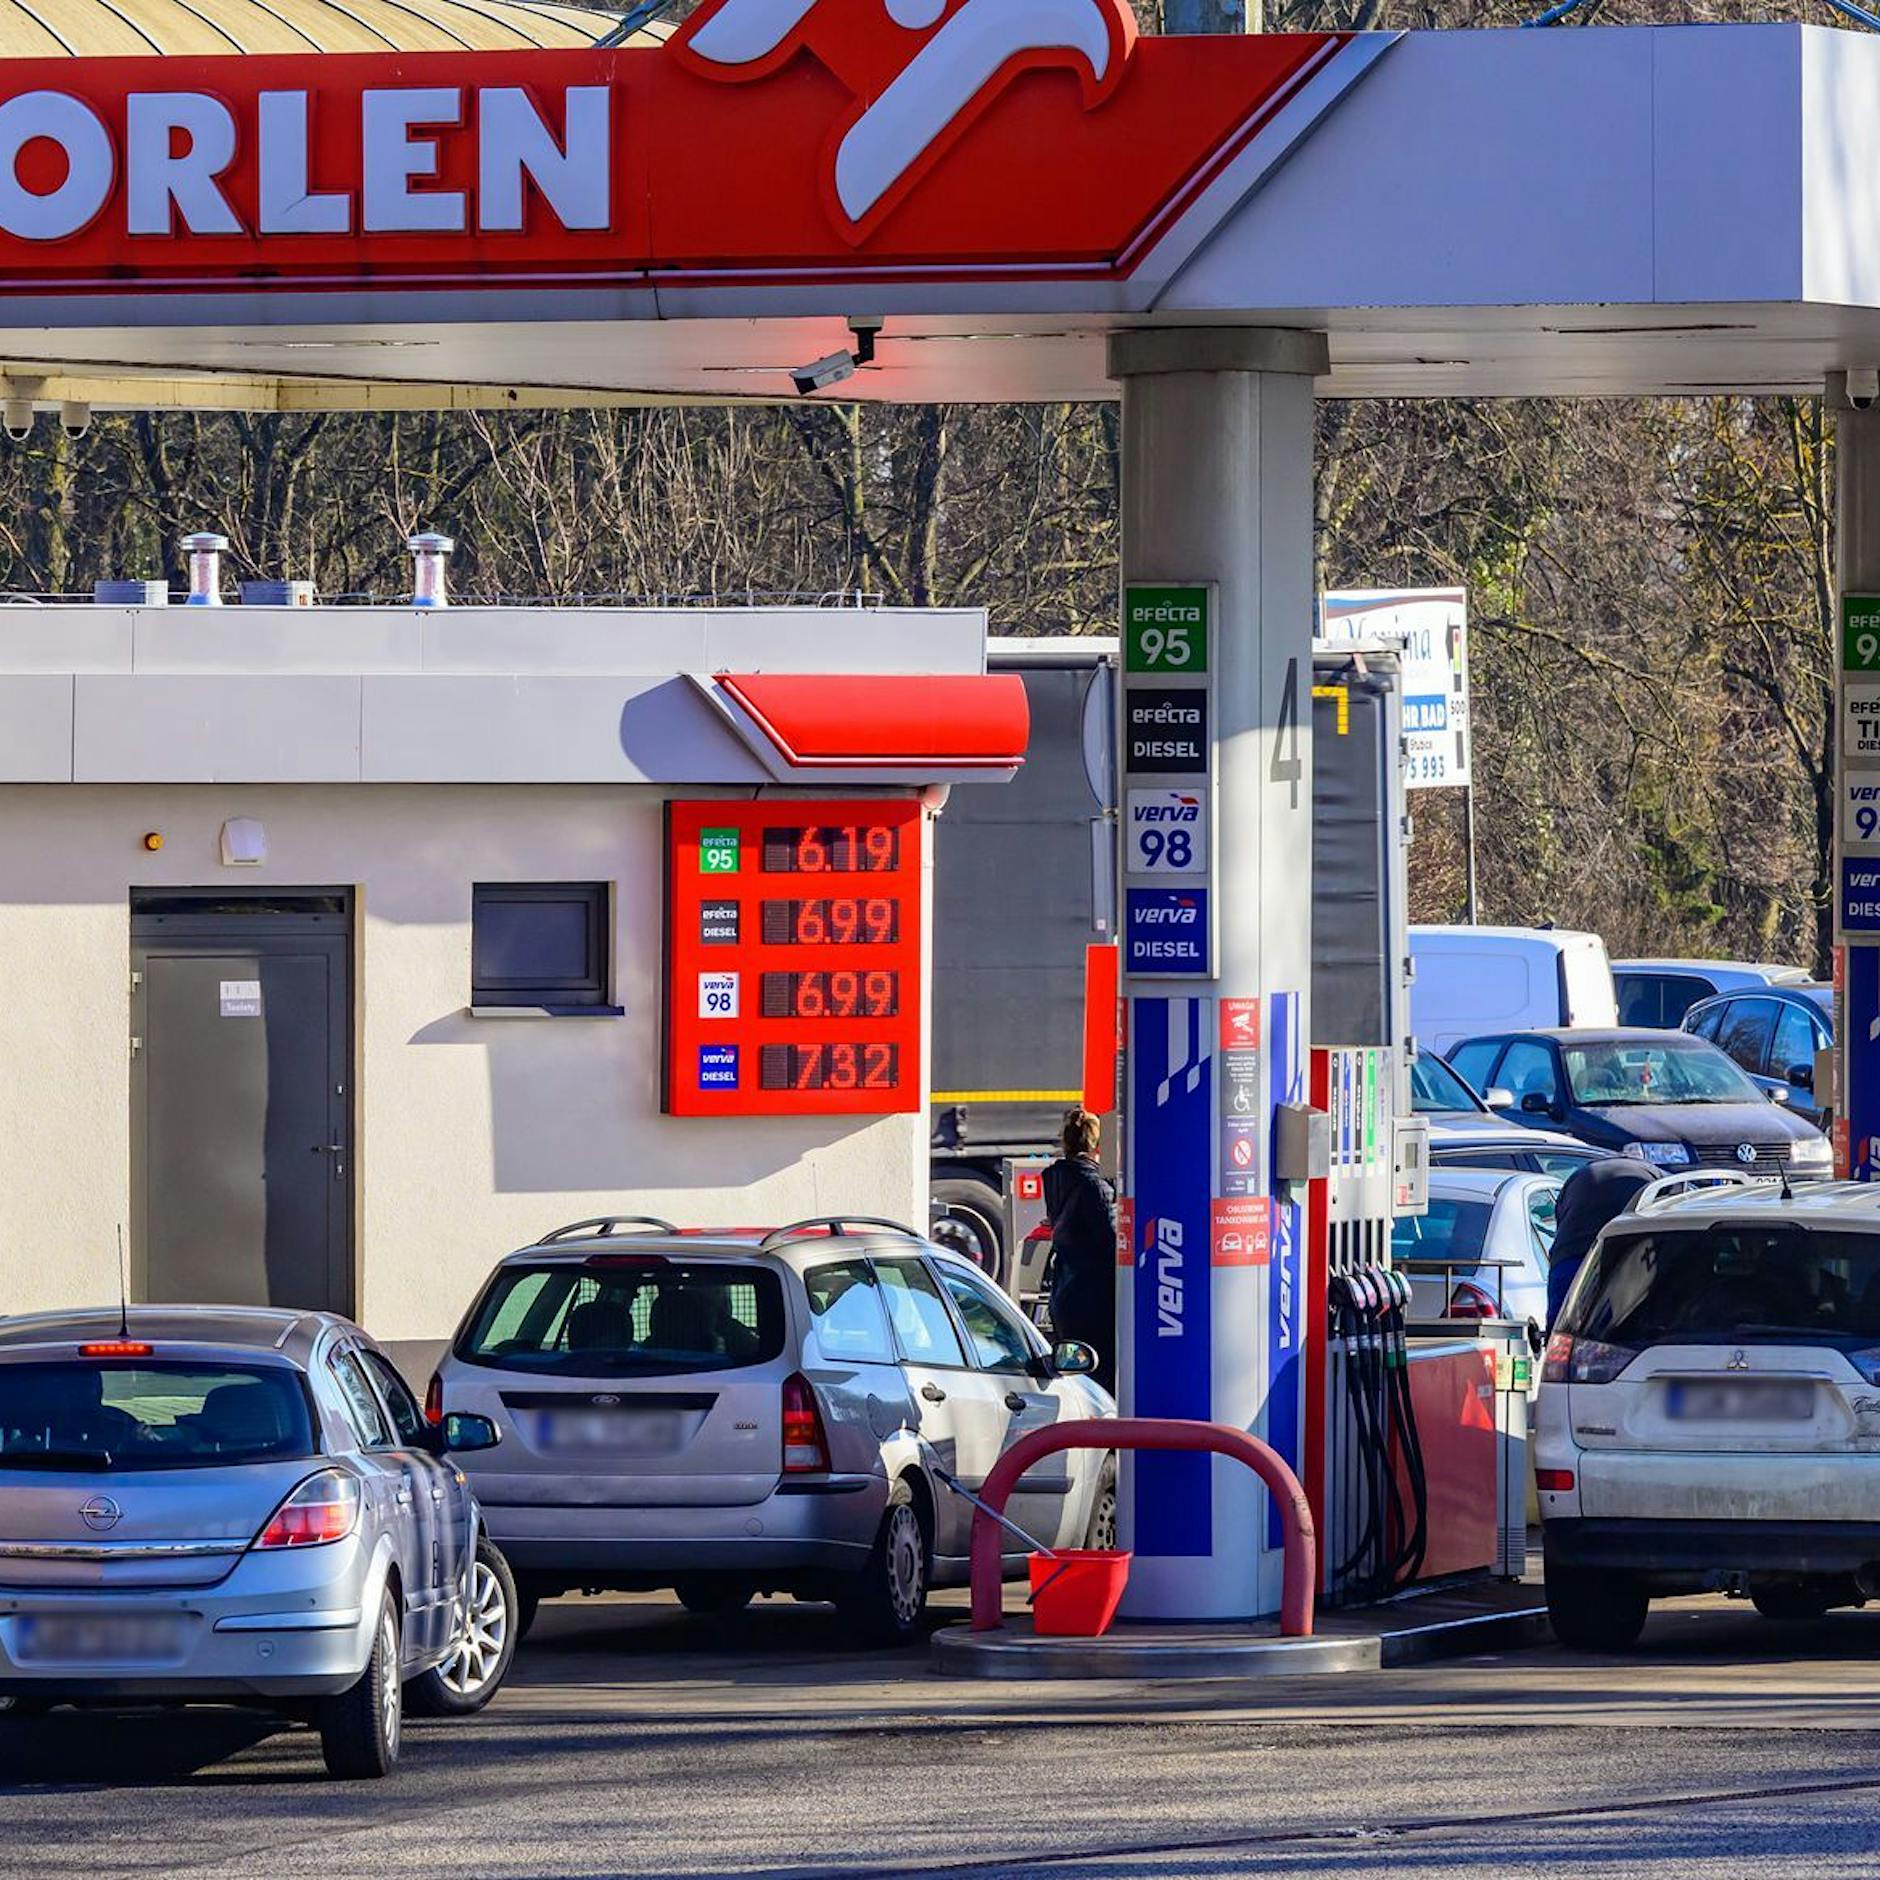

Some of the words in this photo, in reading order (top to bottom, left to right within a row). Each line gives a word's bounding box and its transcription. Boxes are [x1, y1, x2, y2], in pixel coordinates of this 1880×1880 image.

[0, 85, 612, 241] ORLEN
[1140, 628, 1191, 666] 95
[1856, 633, 1880, 665] 9
[1270, 657, 1301, 810] 4
[1134, 741, 1200, 759] DIESEL
[1134, 805, 1200, 823] verva
[1855, 806, 1880, 840] 9
[707, 849, 733, 870] 95
[798, 827, 892, 871] 6.19
[1140, 828, 1192, 868] 98
[703, 926, 737, 938] DIESEL
[797, 900, 892, 944] 6.99
[1134, 907, 1197, 925] verva
[1134, 940, 1200, 959] DIESEL
[704, 979, 735, 990] verva
[797, 972, 892, 1016] 6.99
[706, 993, 731, 1011] 98
[702, 1053, 735, 1064] verva
[796, 1044, 891, 1088] 7.32
[702, 1071, 736, 1082] DIESEL
[1158, 1217, 1184, 1338] verva
